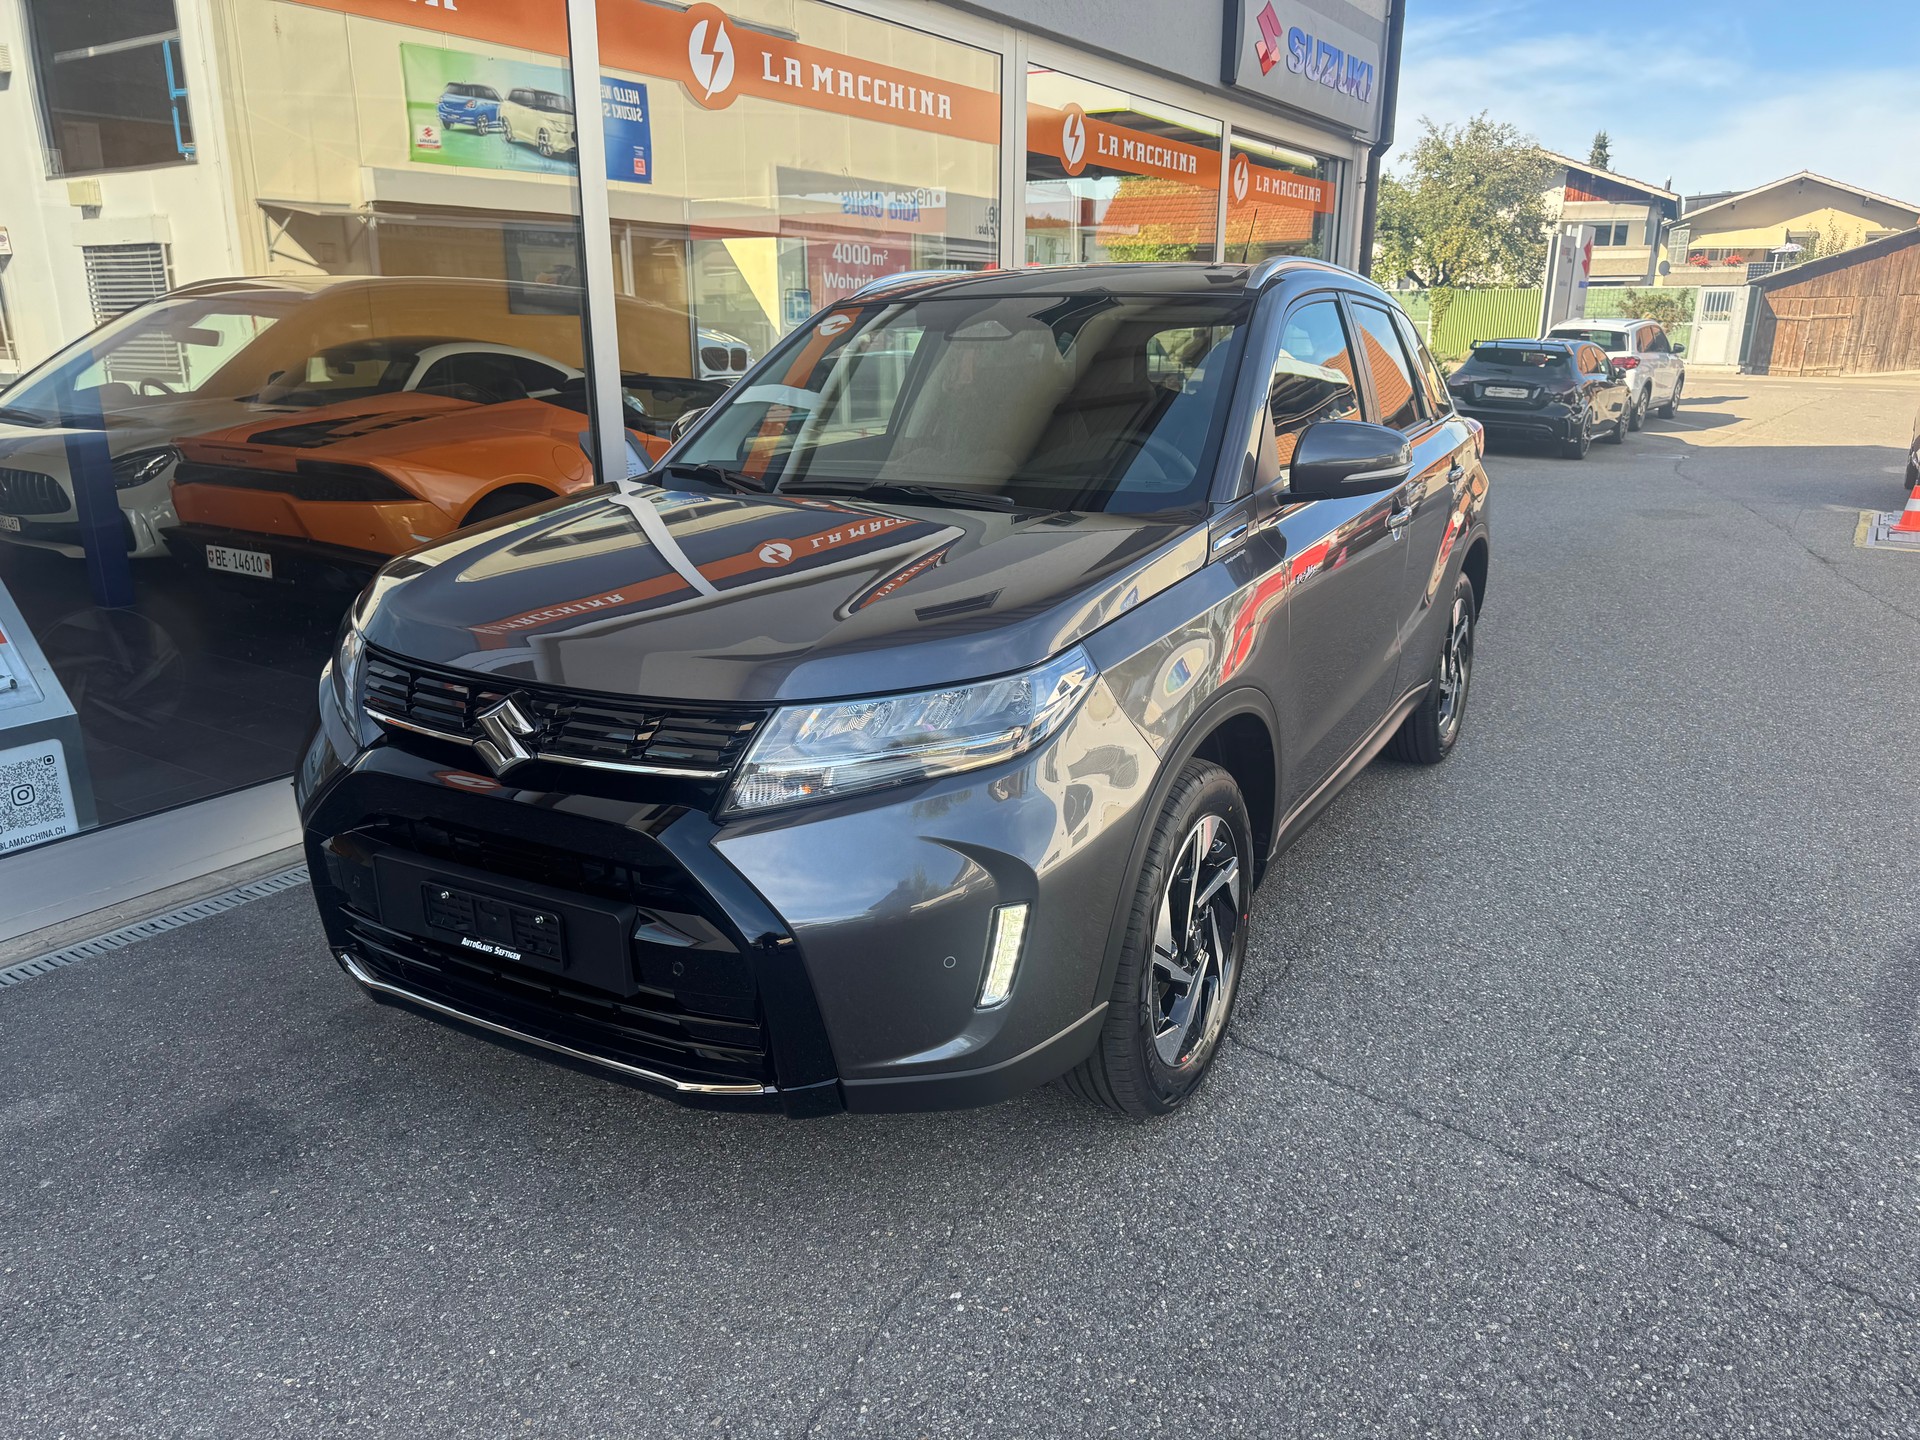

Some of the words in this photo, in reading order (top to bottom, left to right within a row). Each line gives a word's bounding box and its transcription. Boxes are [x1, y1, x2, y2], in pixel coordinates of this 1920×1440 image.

[761, 51, 803, 88] LA
[811, 63, 952, 120] MACCHINA
[1286, 26, 1373, 104] SUZUKI
[1097, 132, 1119, 157] LA
[1122, 138, 1197, 175] MACCHINA
[1256, 174, 1270, 193] LA
[1271, 178, 1321, 203] MACCHINA
[832, 243, 871, 265] 4000
